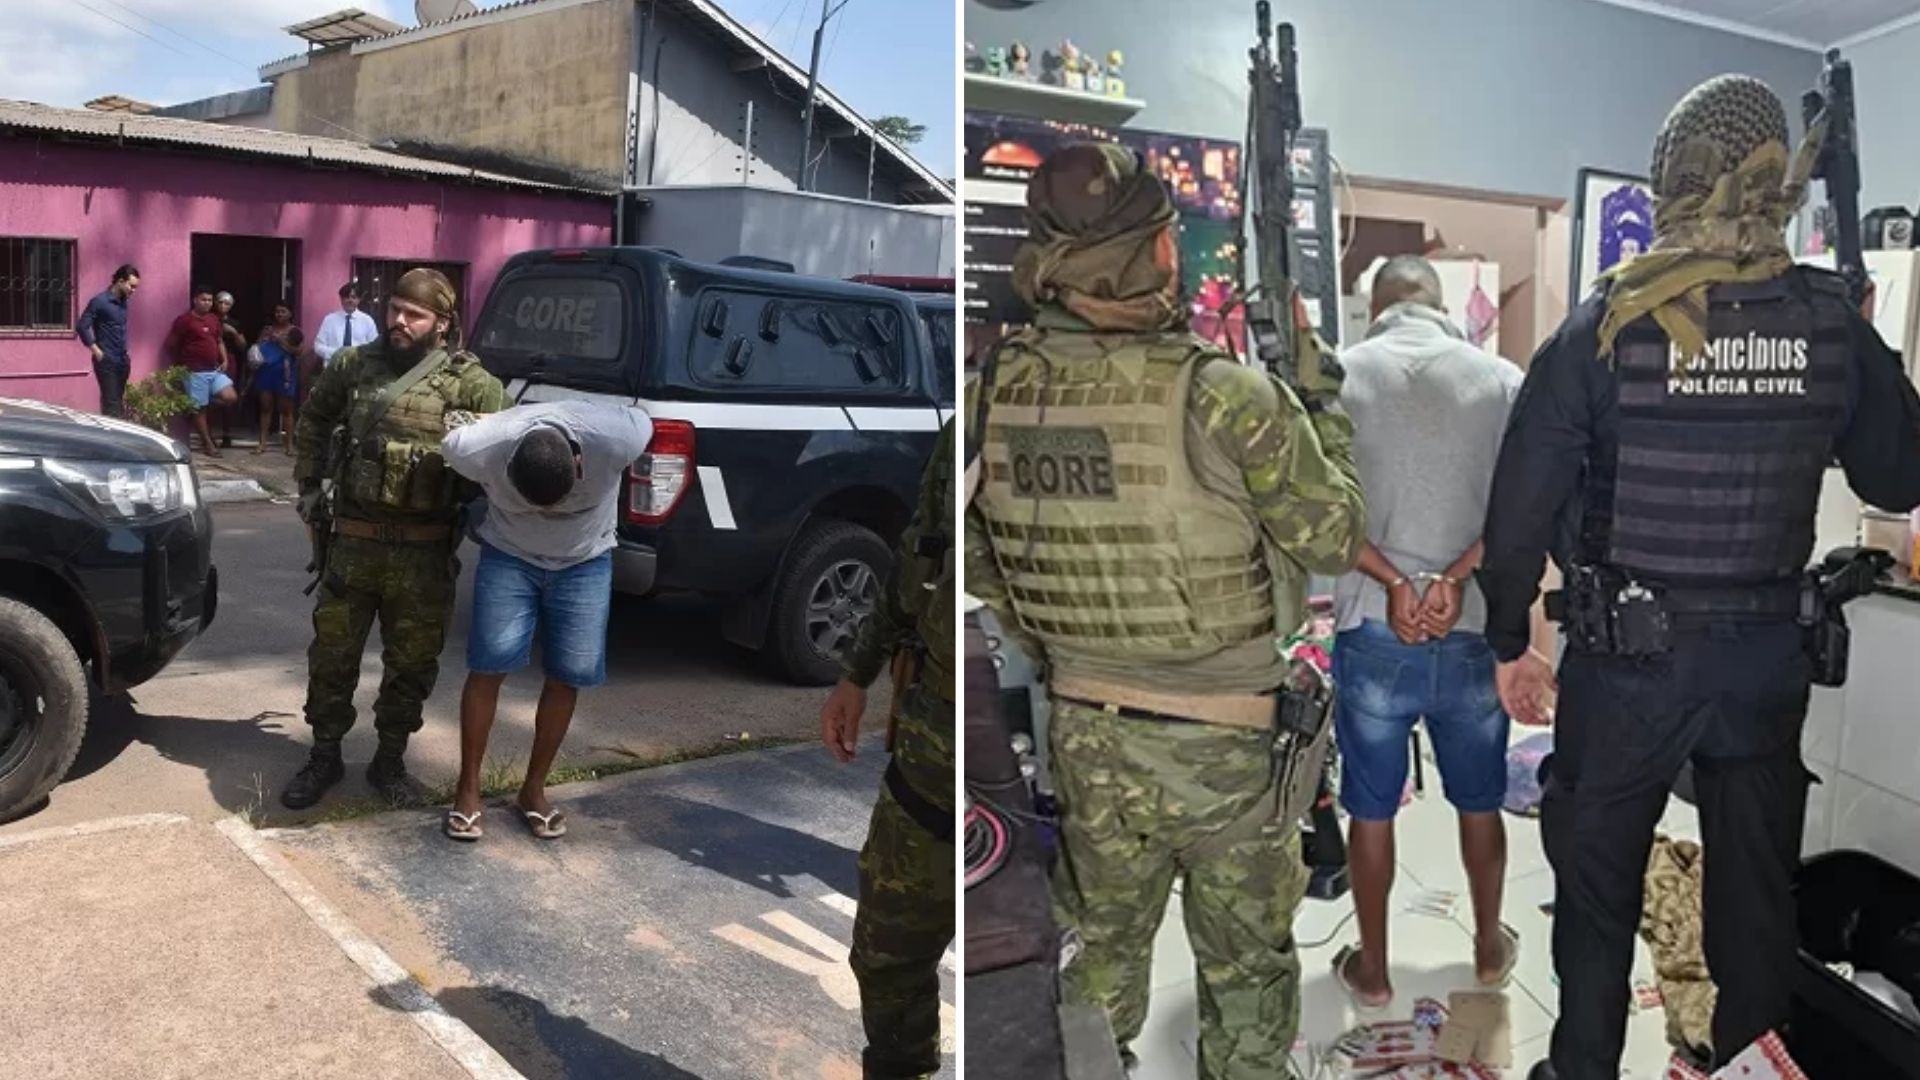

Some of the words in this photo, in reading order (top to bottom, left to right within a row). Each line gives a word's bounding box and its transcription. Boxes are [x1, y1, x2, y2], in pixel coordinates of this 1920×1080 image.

[515, 296, 597, 332] CORE
[1667, 375, 1748, 394] POLÍCIA
[1754, 377, 1806, 394] CIVIL
[1013, 453, 1113, 494] CORE
